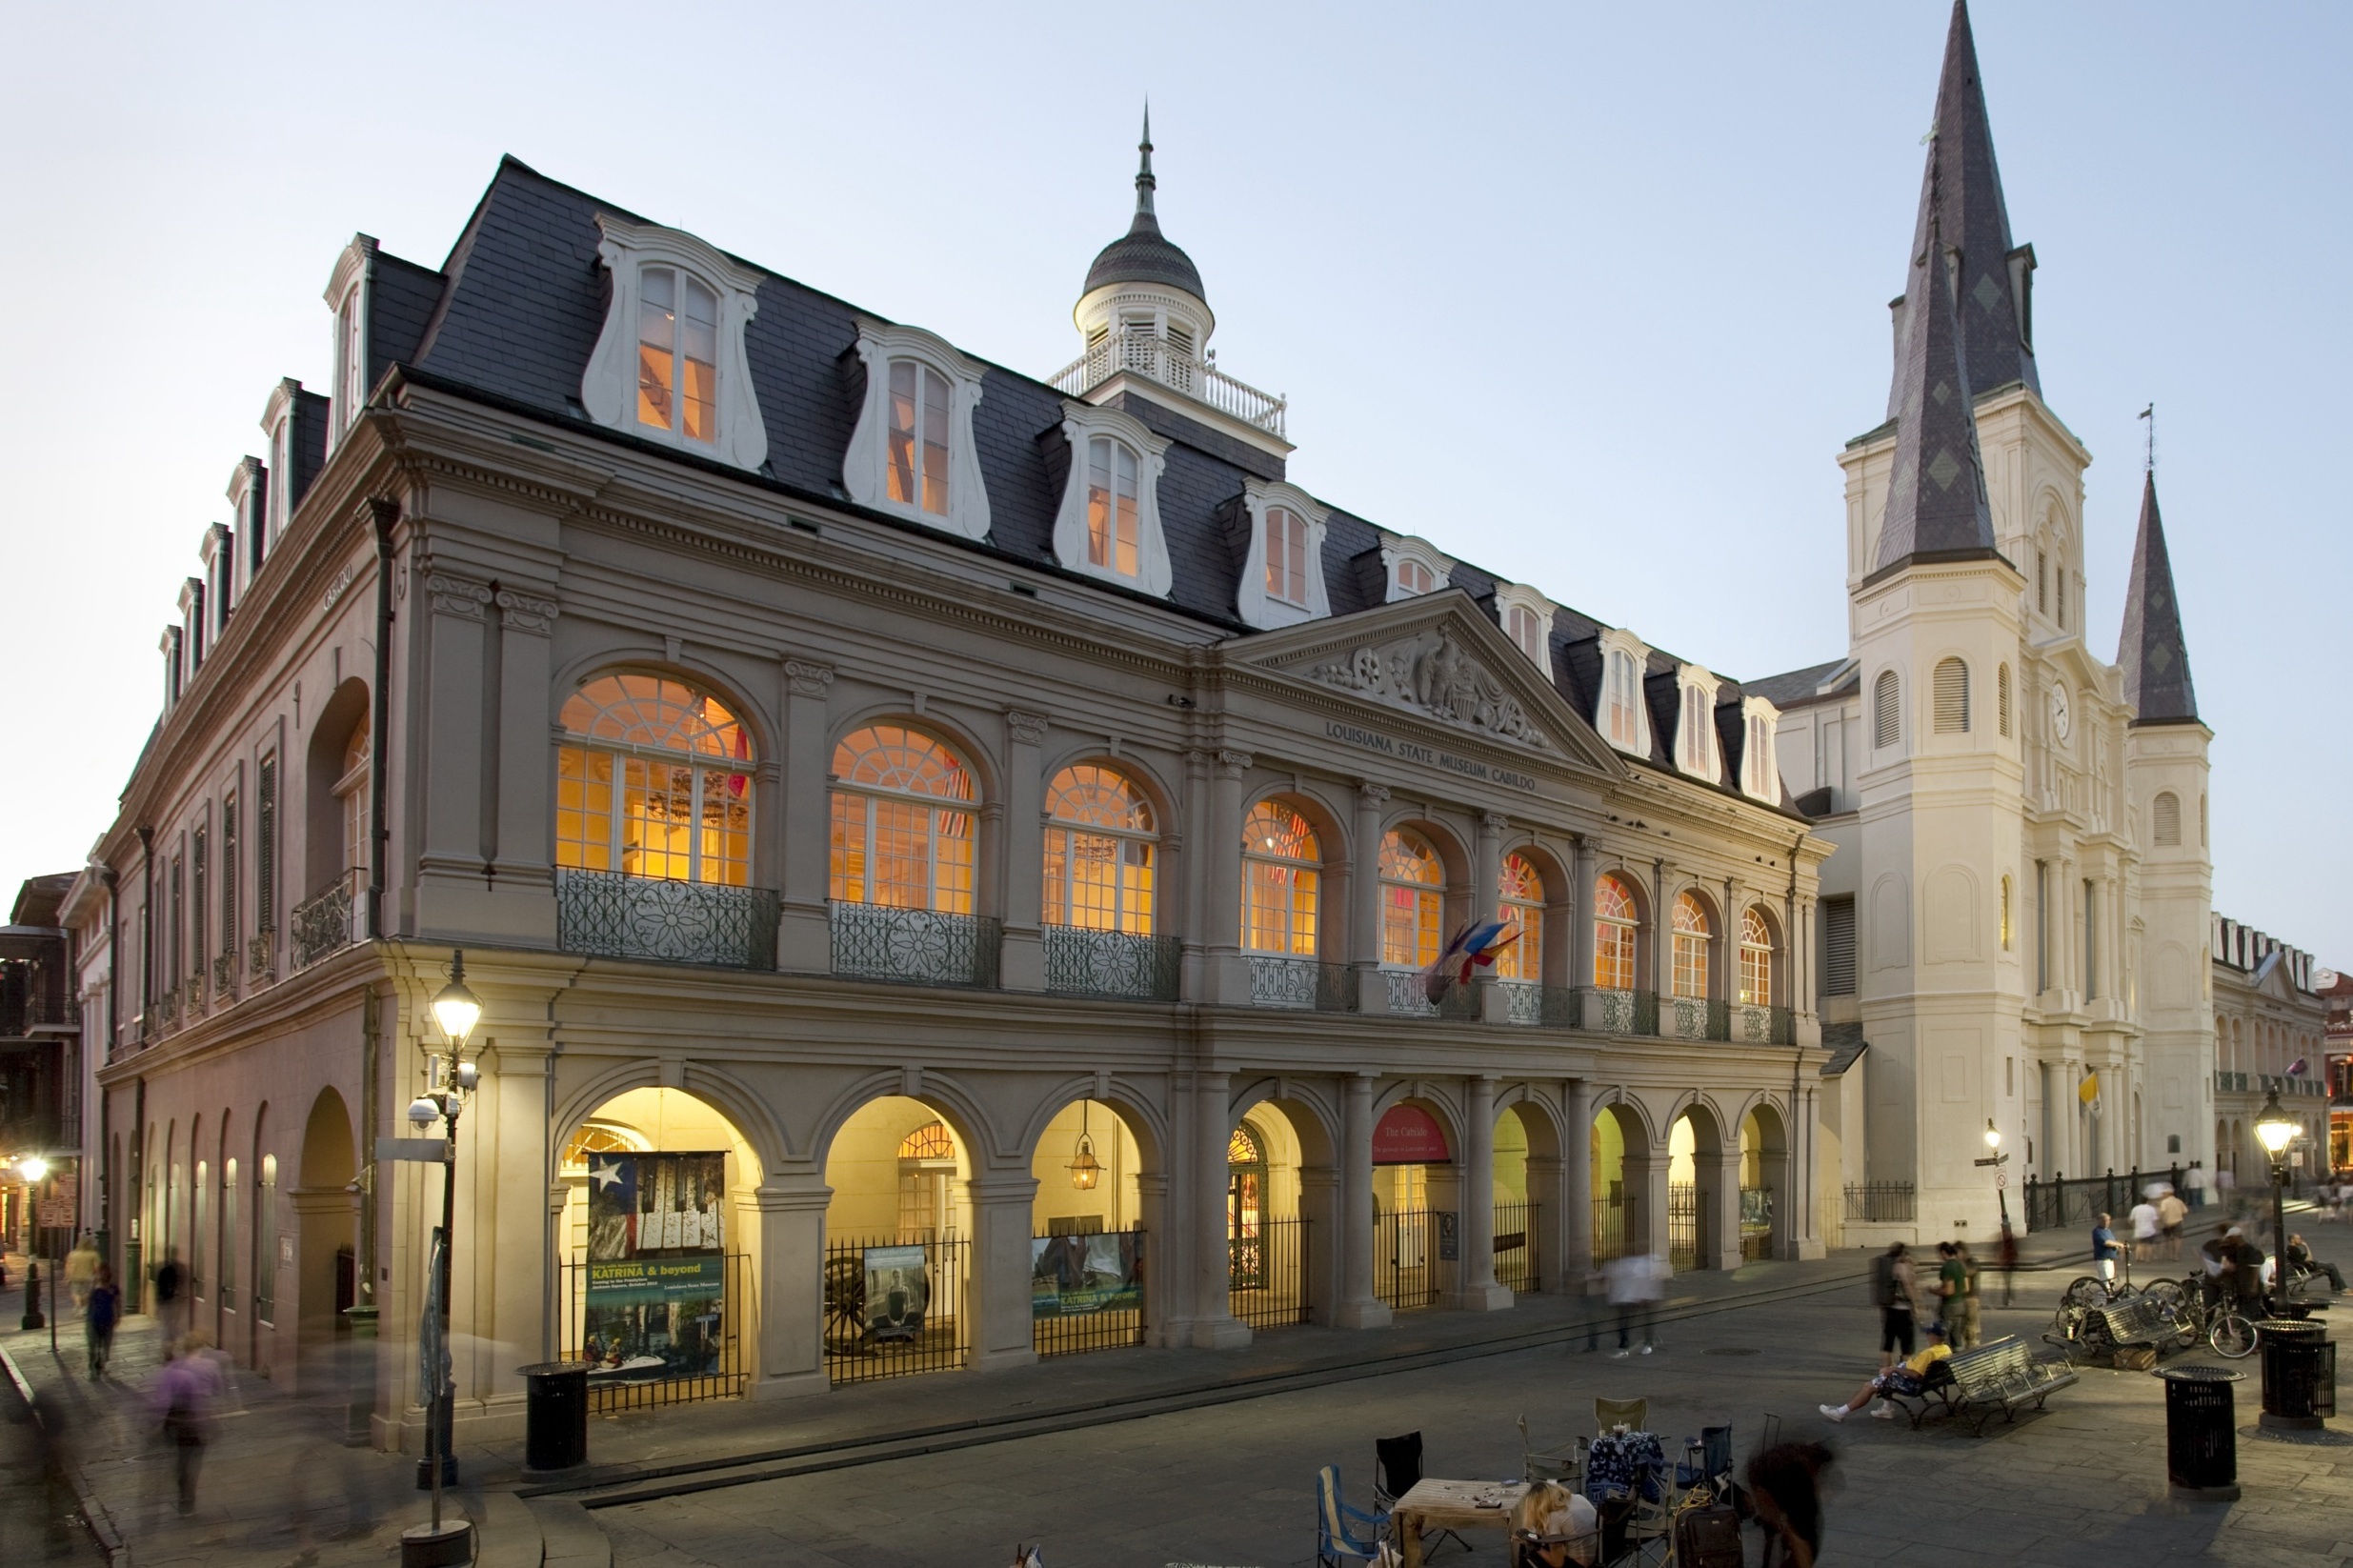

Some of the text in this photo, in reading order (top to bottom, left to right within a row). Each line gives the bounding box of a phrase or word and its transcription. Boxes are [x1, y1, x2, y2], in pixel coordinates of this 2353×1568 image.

[1325, 721, 1536, 792] LOUISIANA STATE MUSEUM CABILDO
[1385, 1127, 1428, 1137] The Cabildo
[592, 1263, 702, 1279] KATRINA & beyond
[1060, 1294, 1098, 1305] KATRINA
[1099, 1293, 1108, 1302] &
